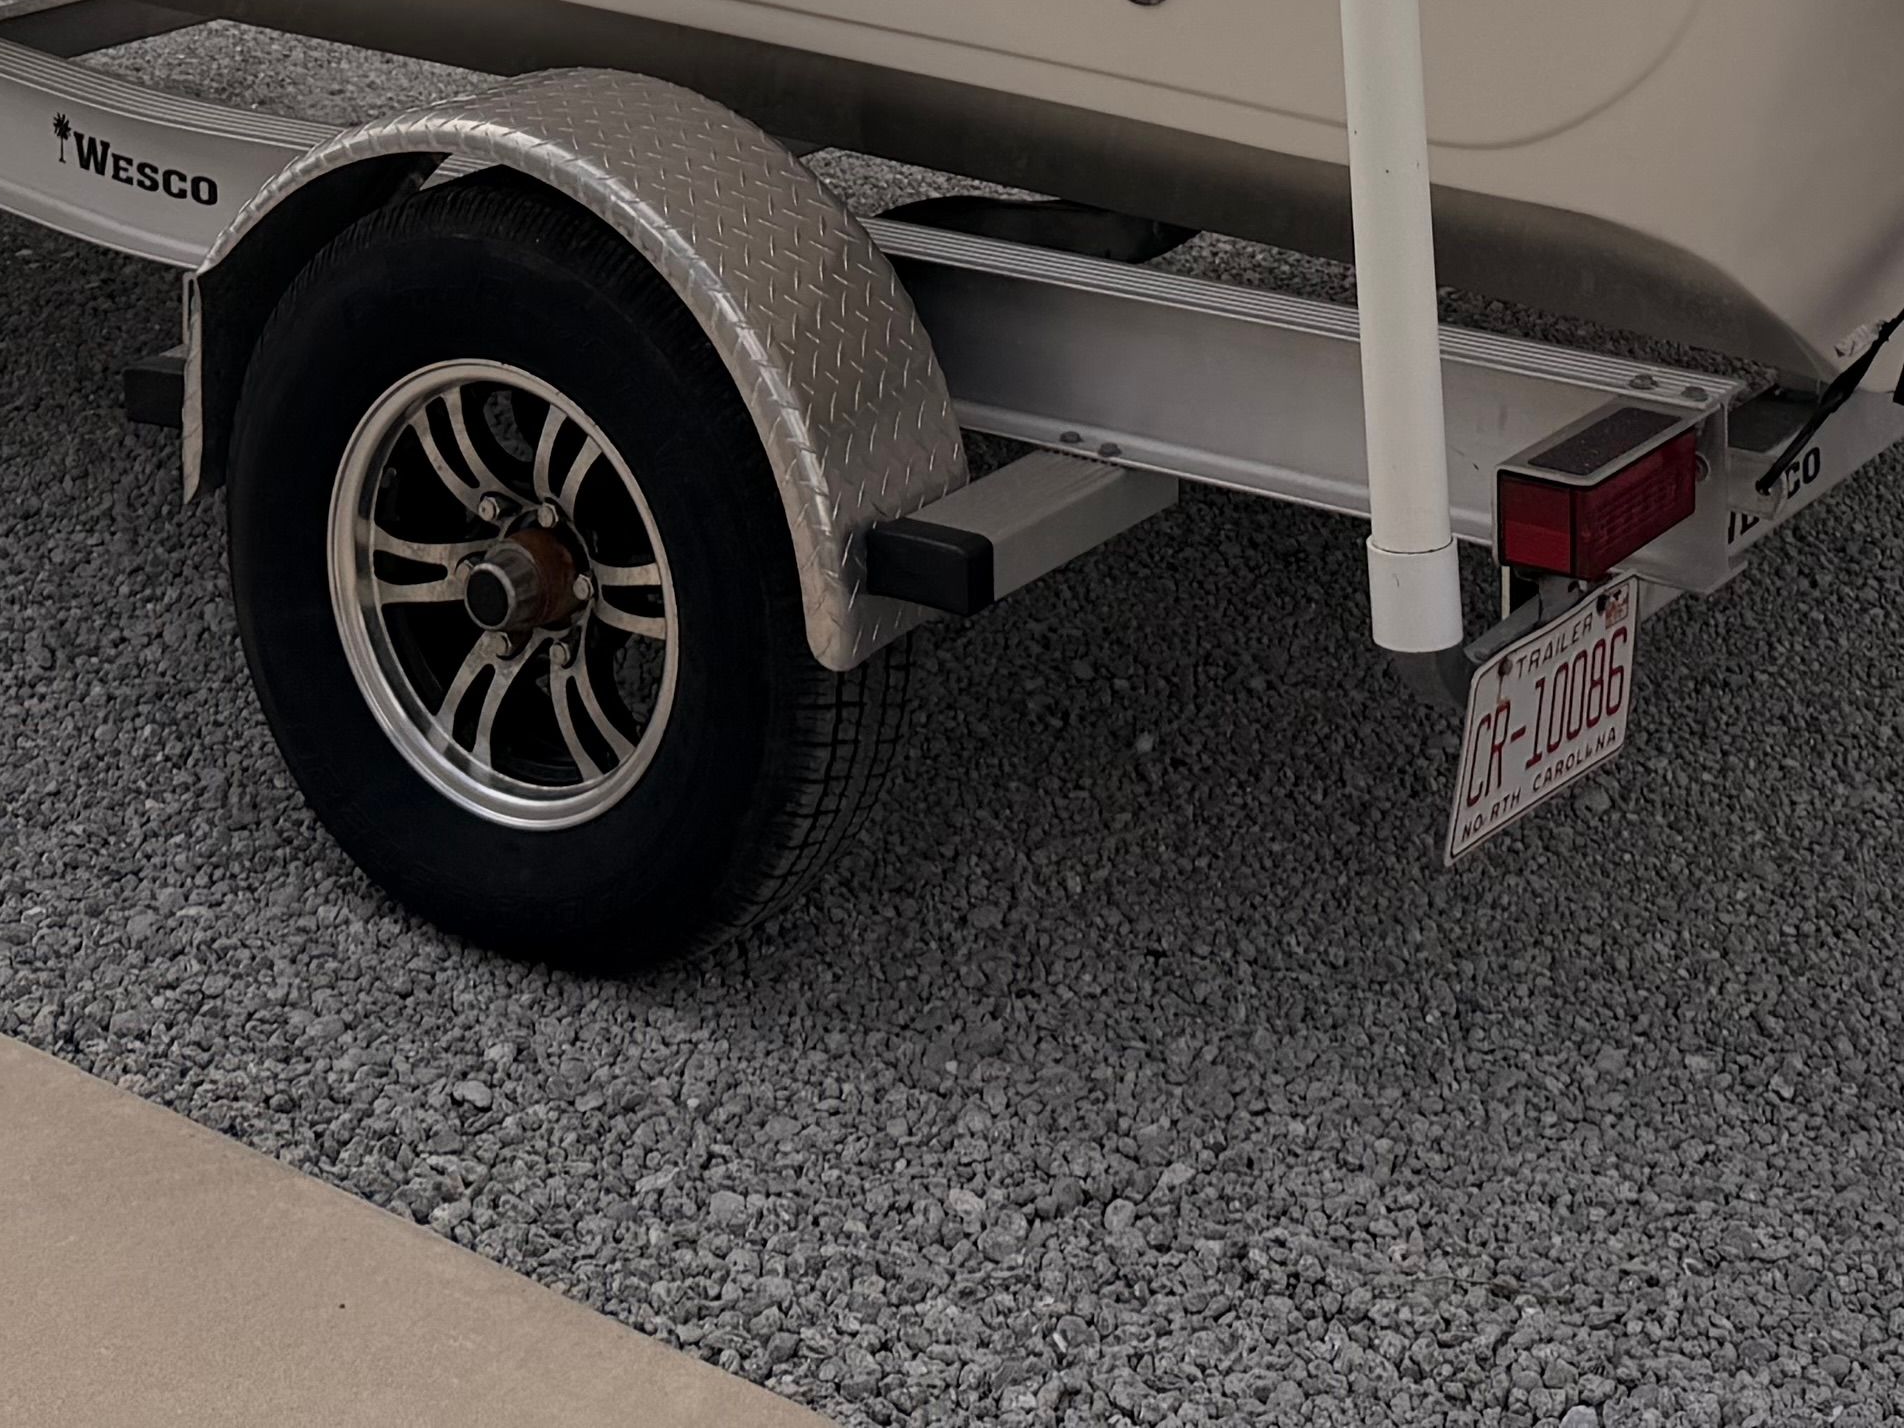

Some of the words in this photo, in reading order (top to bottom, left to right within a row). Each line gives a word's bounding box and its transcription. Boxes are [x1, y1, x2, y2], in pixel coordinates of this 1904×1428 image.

[73, 130, 218, 206] WESCO
[1516, 612, 1594, 680] TRAILER
[1467, 626, 1628, 808] CR-10086
[1462, 787, 1522, 840] NORTH
[1533, 727, 1616, 792] CAROLINA
